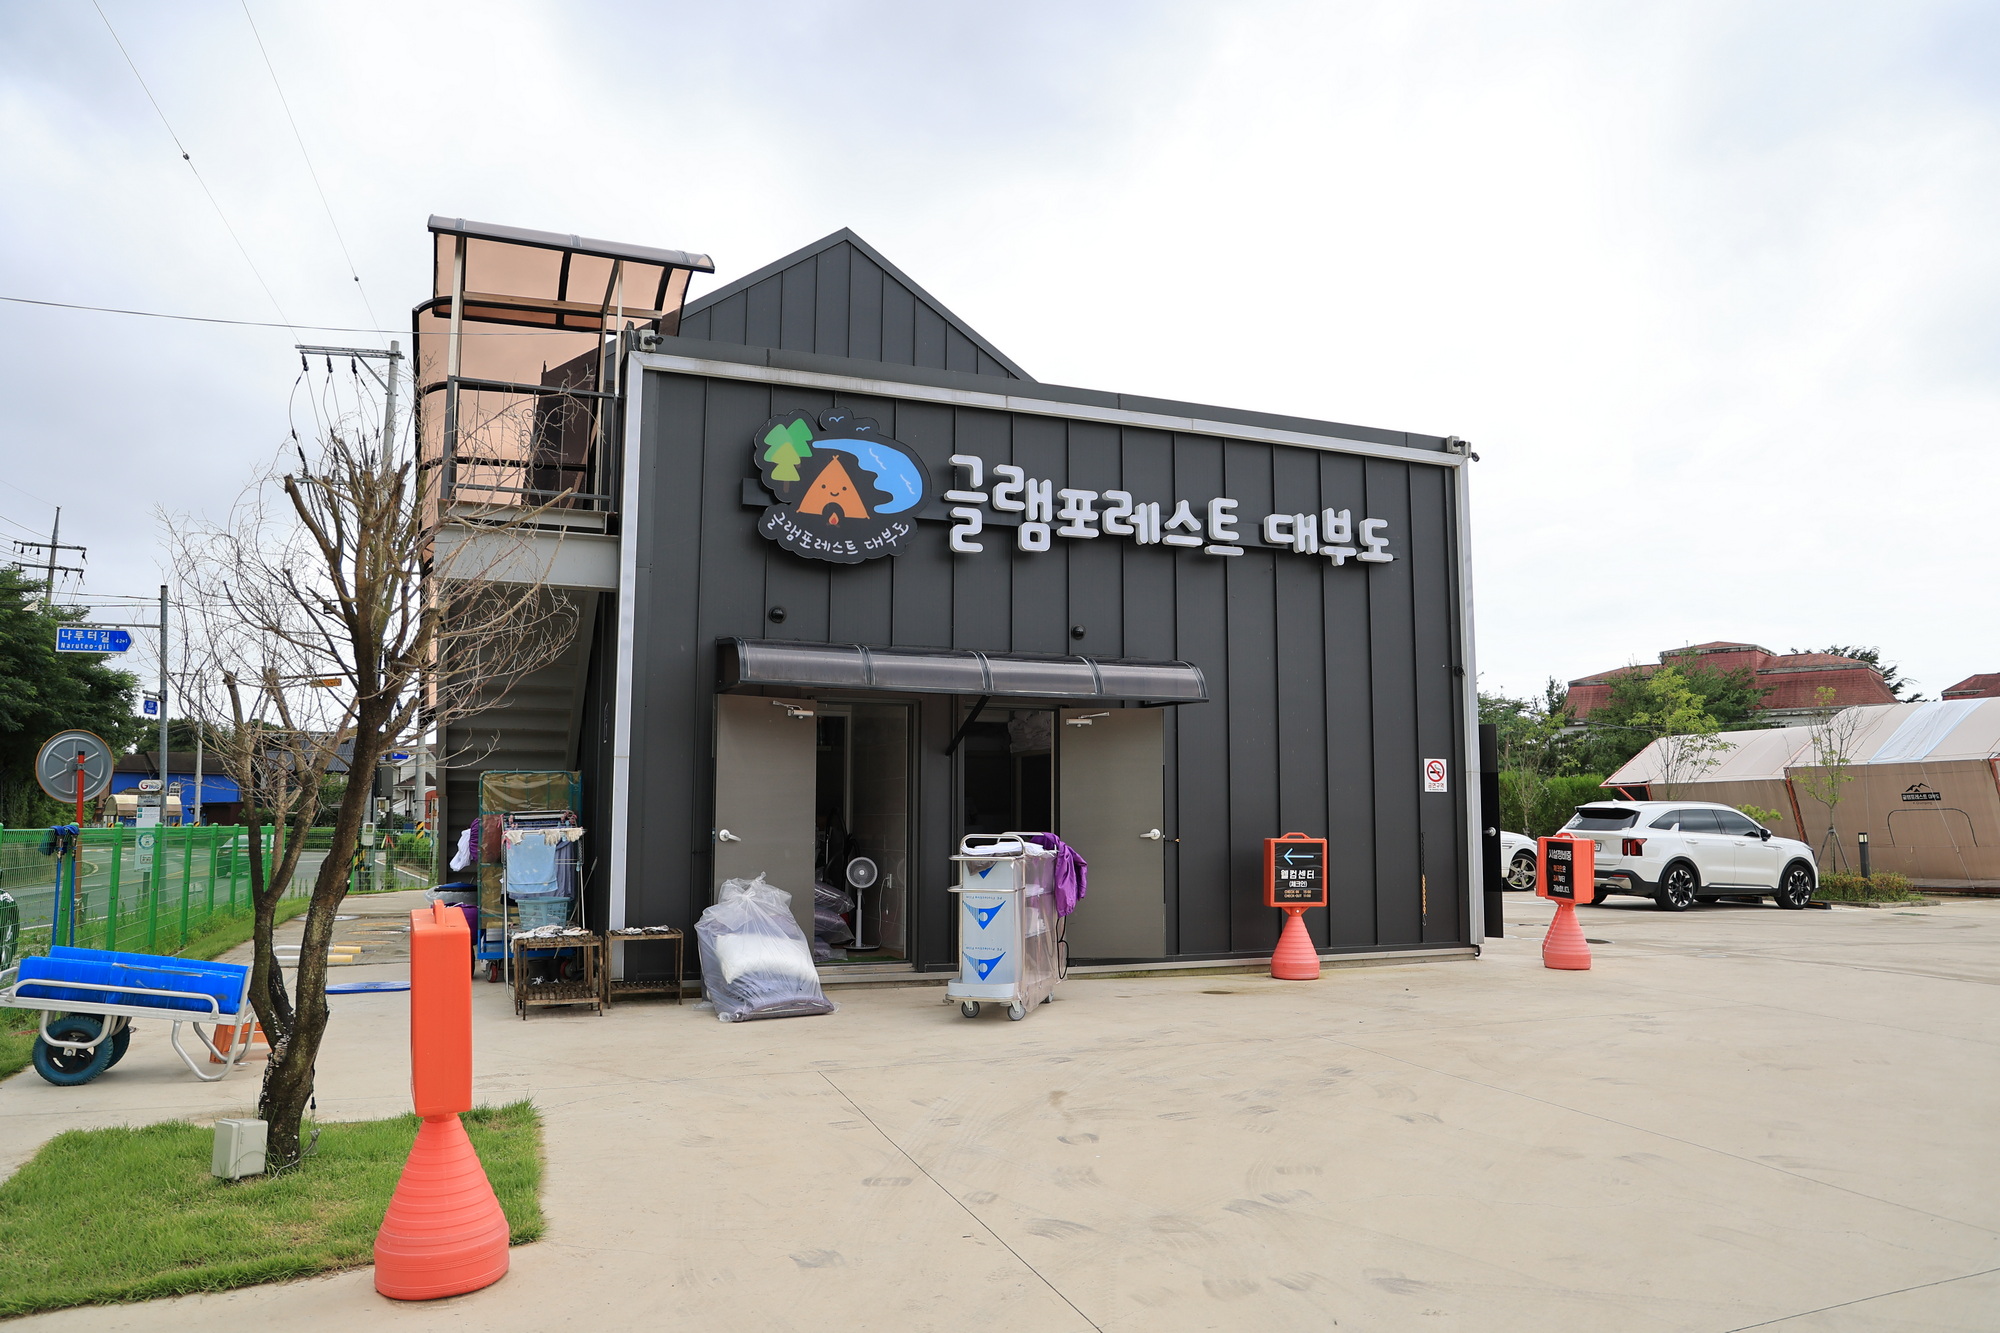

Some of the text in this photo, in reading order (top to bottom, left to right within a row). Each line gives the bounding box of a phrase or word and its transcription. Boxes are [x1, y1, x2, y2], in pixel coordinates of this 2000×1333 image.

[943, 454, 1394, 567] 글램포레스트 대부도
[767, 512, 910, 555] 글램포레스트 대부도
[60, 642, 110, 650] Naruteo-gil
[61, 630, 110, 644] 나루터길
